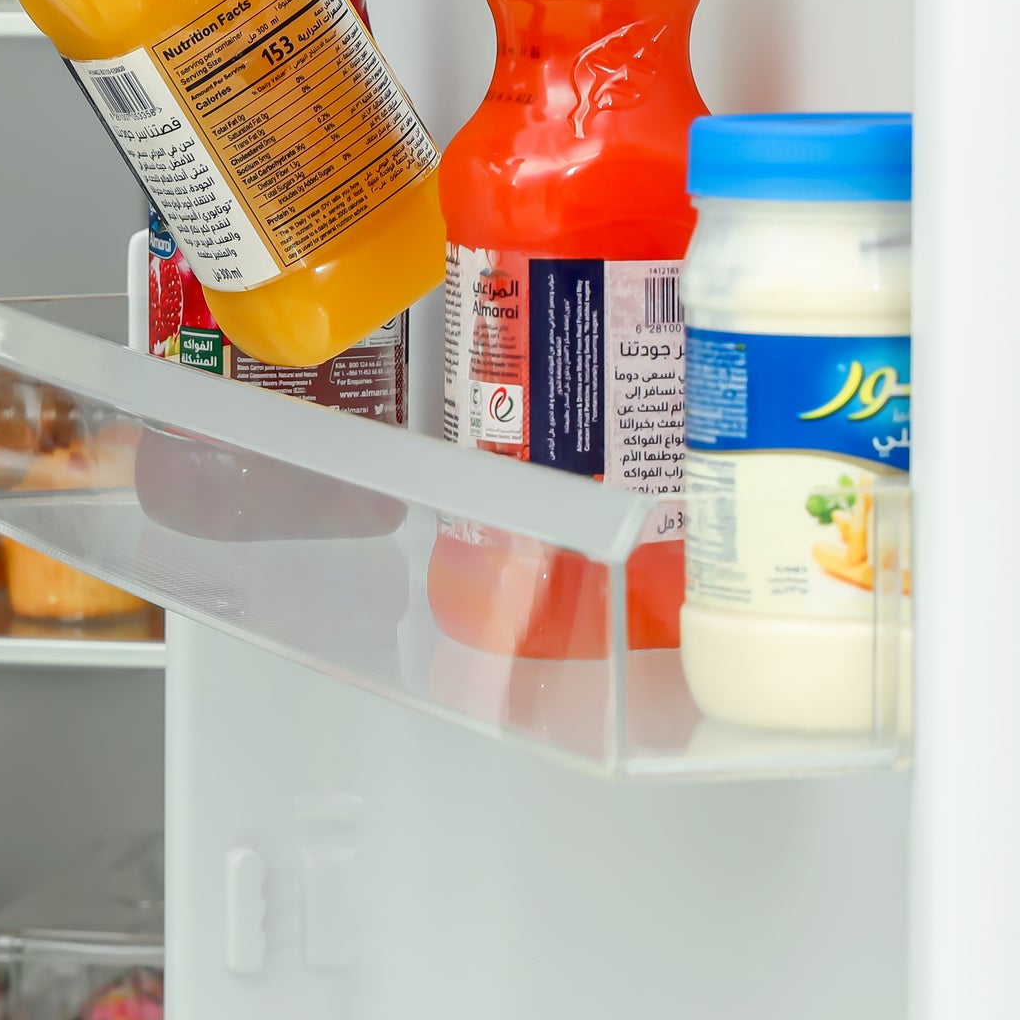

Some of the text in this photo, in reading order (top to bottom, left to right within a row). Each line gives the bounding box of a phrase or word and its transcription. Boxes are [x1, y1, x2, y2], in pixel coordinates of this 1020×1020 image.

[256, 23, 269, 35] 300
[161, 19, 218, 61] Nutrition
[179, 56, 205, 77] serving
[202, 49, 215, 61] per
[213, 30, 243, 53] container
[180, 55, 222, 86] Serving Size
[194, 34, 296, 112] Calories 153
[190, 83, 214, 101] Amount
[212, 76, 224, 86] Per
[212, 123, 228, 137] Total
[226, 117, 238, 127] Fat
[177, 136, 196, 152] نحن
[233, 137, 249, 151] Trans
[230, 141, 265, 167] Cholesterol
[241, 172, 258, 186] Total
[256, 147, 297, 177] Carbohydrate
[266, 208, 289, 226] Protein
[473, 280, 518, 301] المراعي
[473, 302, 518, 319] Almarai
[636, 325, 641, 333] 6
[184, 339, 213, 352] الفواكه
[620, 341, 671, 360] جودتنا
[181, 353, 217, 367] المشكلة
[614, 366, 638, 382] دوماً
[642, 369, 675, 382] نسعى
[625, 386, 640, 399] إلى
[643, 386, 675, 398] نسافر
[617, 402, 668, 415] للبحث عن
[619, 419, 654, 431] بخبرائنا
[624, 434, 661, 448] الفواكه
[644, 451, 685, 461] موطنها
[624, 467, 661, 480] الفواكه
